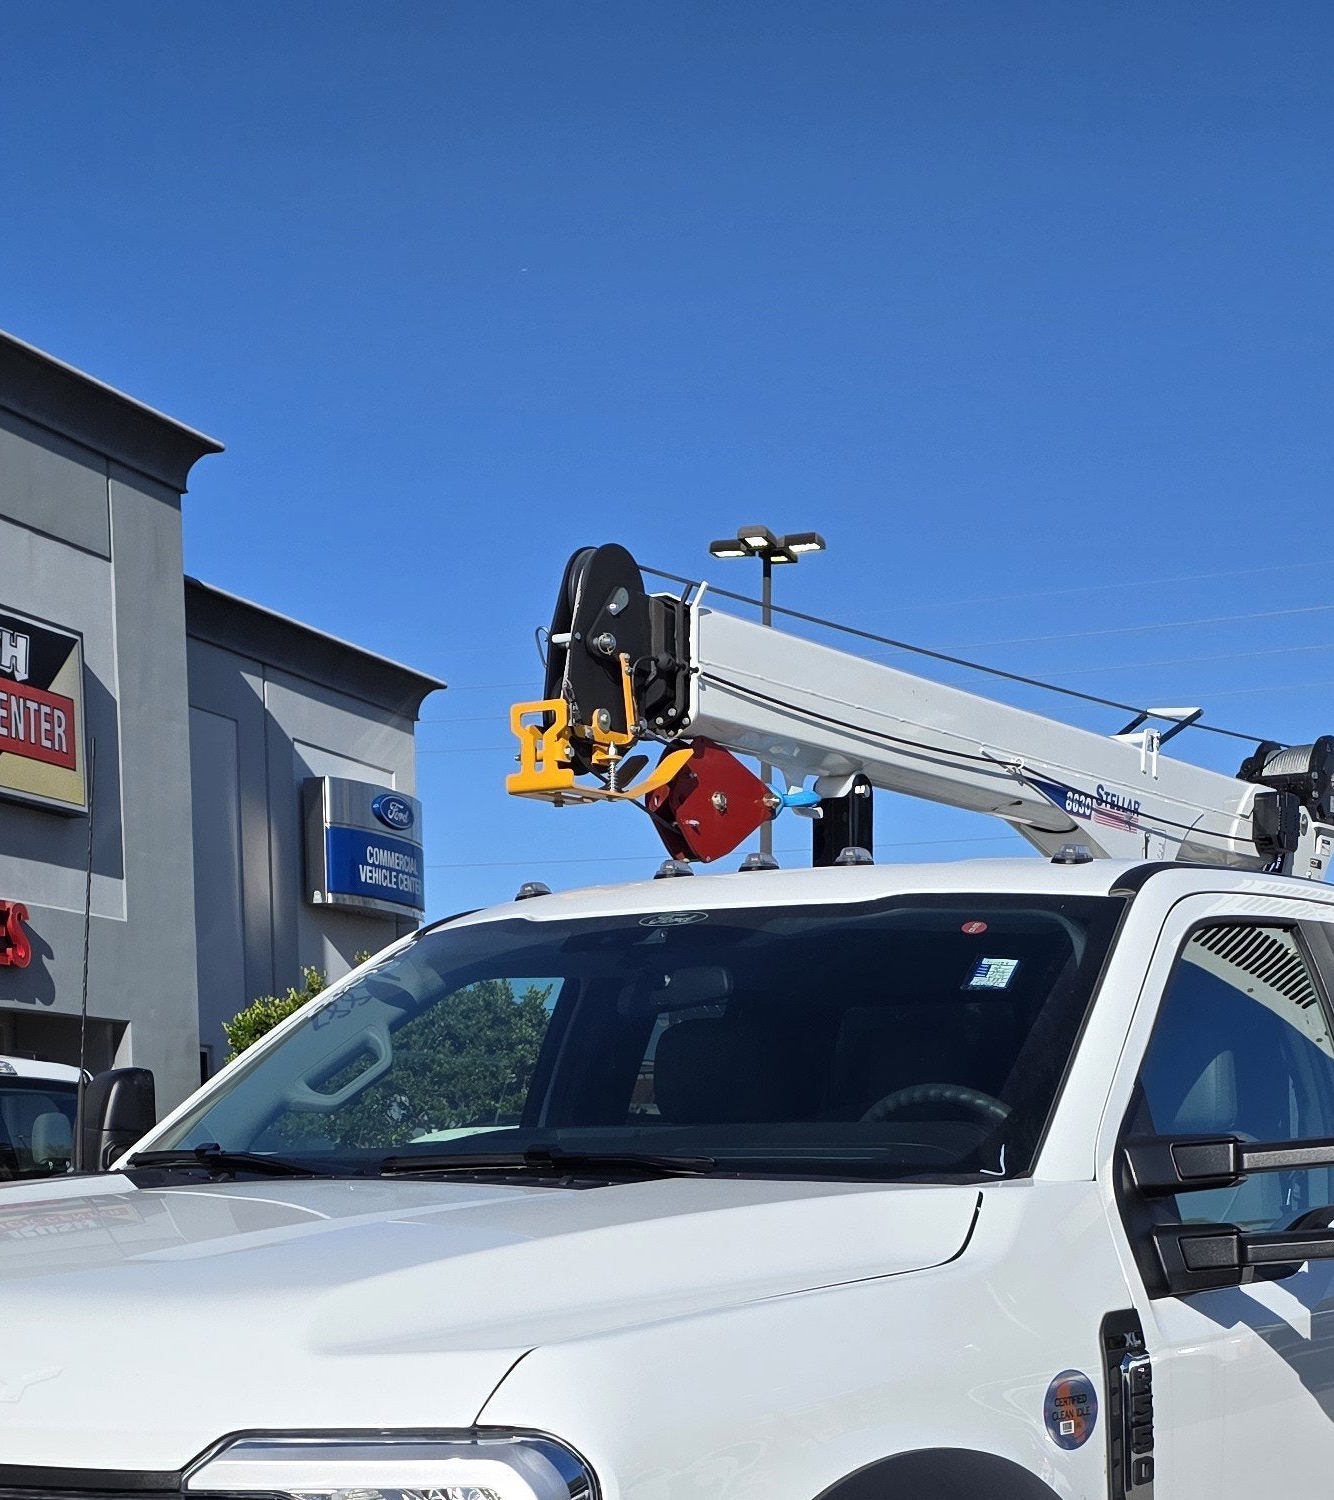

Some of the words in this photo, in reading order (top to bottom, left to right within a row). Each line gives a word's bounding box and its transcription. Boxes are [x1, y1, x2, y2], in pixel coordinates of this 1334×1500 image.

[387, 801, 409, 823] Ford
[1096, 784, 1142, 818] STELLAR
[366, 845, 419, 876] COMMERCIAL
[359, 864, 397, 889] VEHICLE
[1054, 1393, 1087, 1407] CERTIFIED
[1051, 1409, 1074, 1421] CLEAN
